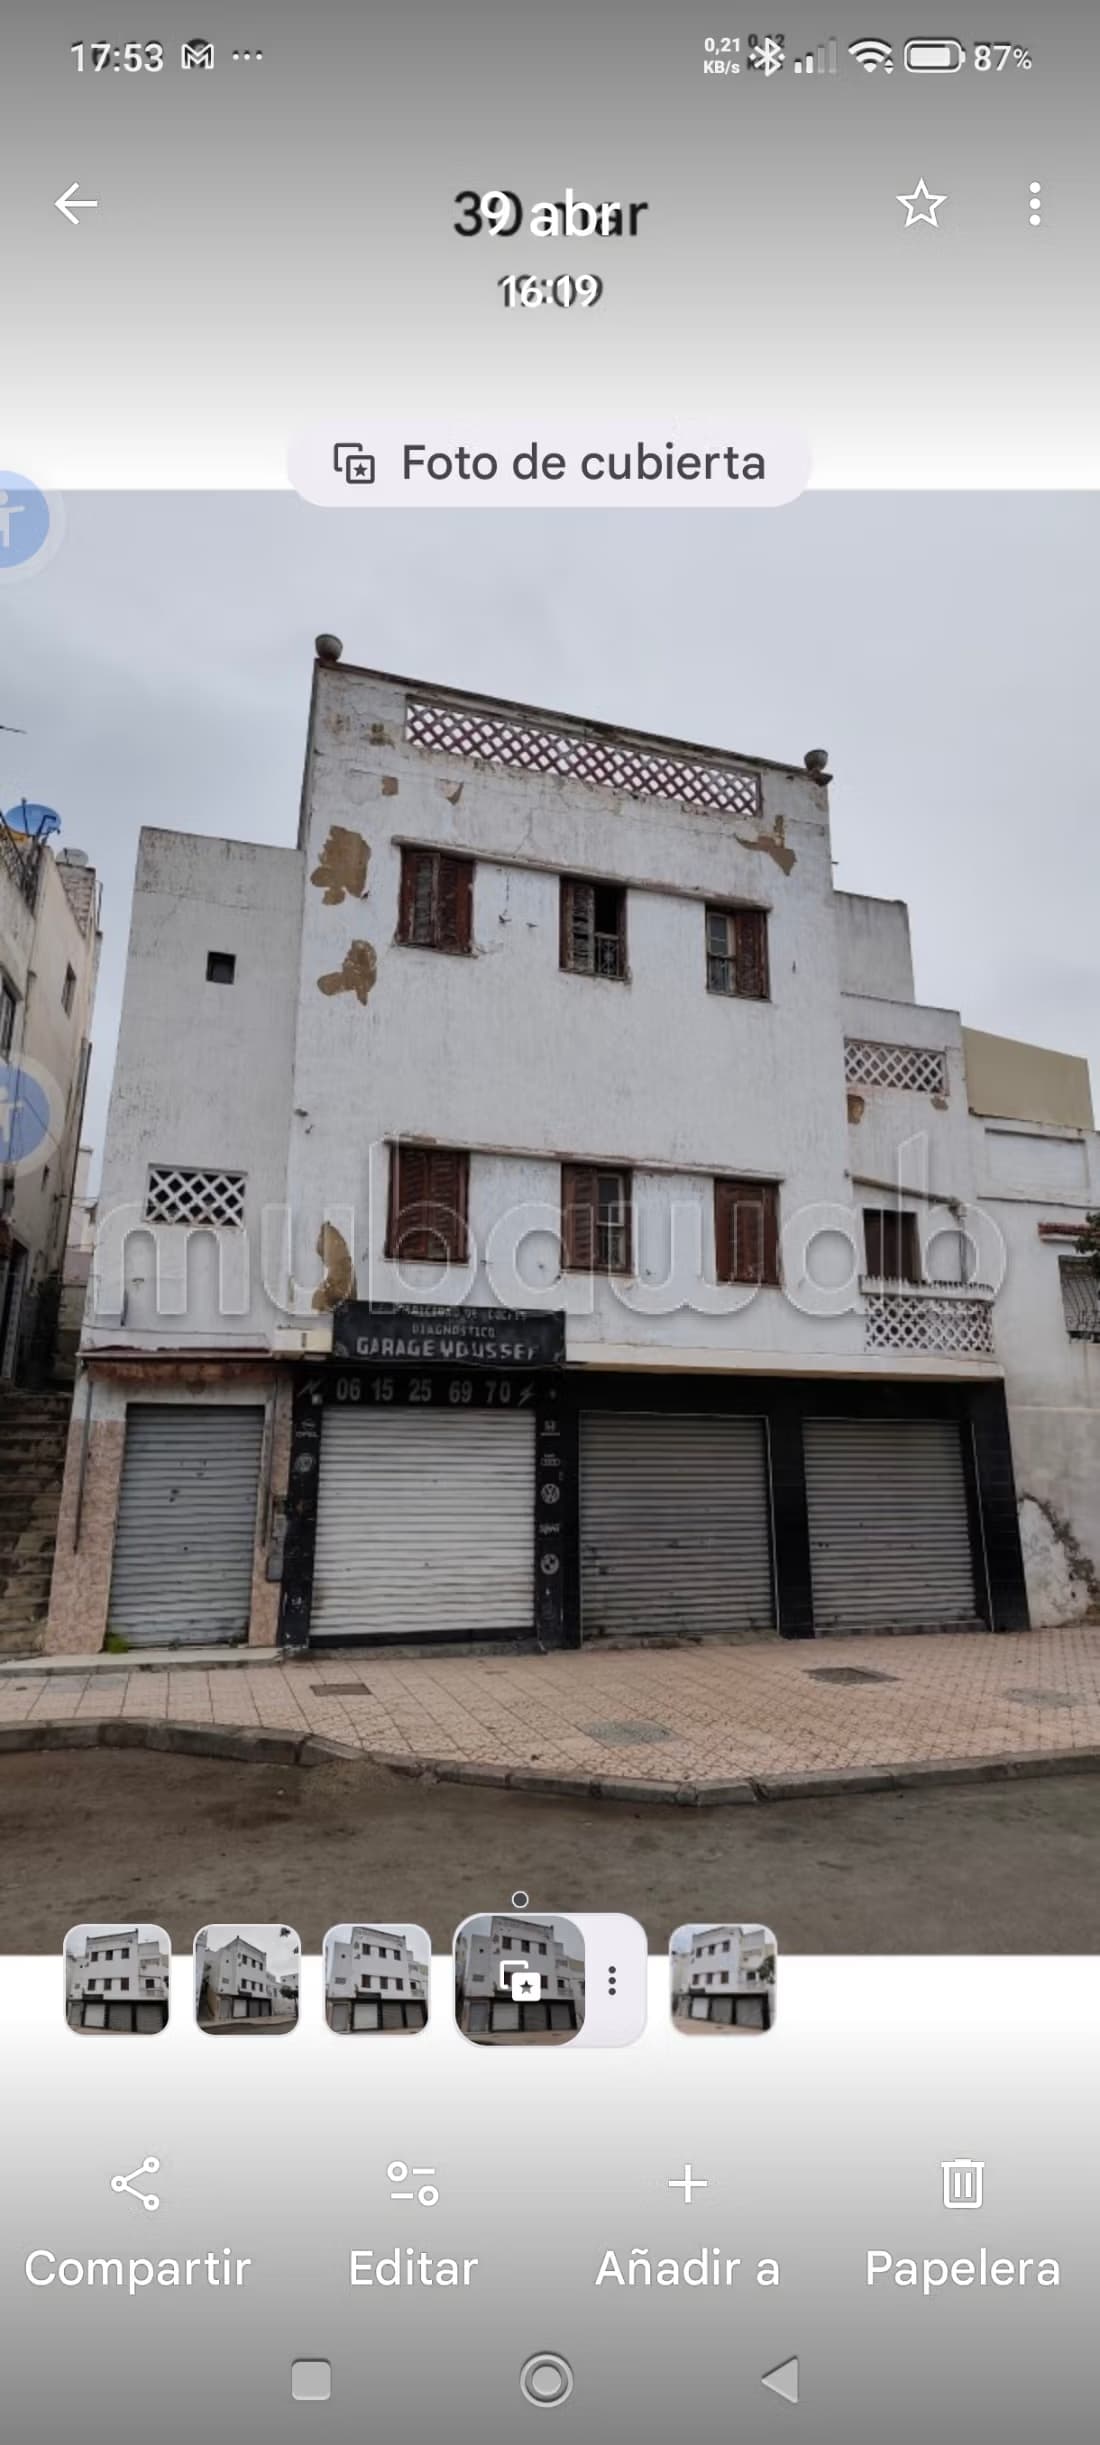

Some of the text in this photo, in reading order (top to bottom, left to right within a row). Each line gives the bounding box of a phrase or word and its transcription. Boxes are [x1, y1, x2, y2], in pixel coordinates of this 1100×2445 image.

[356, 1336, 435, 1357] GARAGE
[336, 1376, 512, 1404] 06 15 25 69 70
